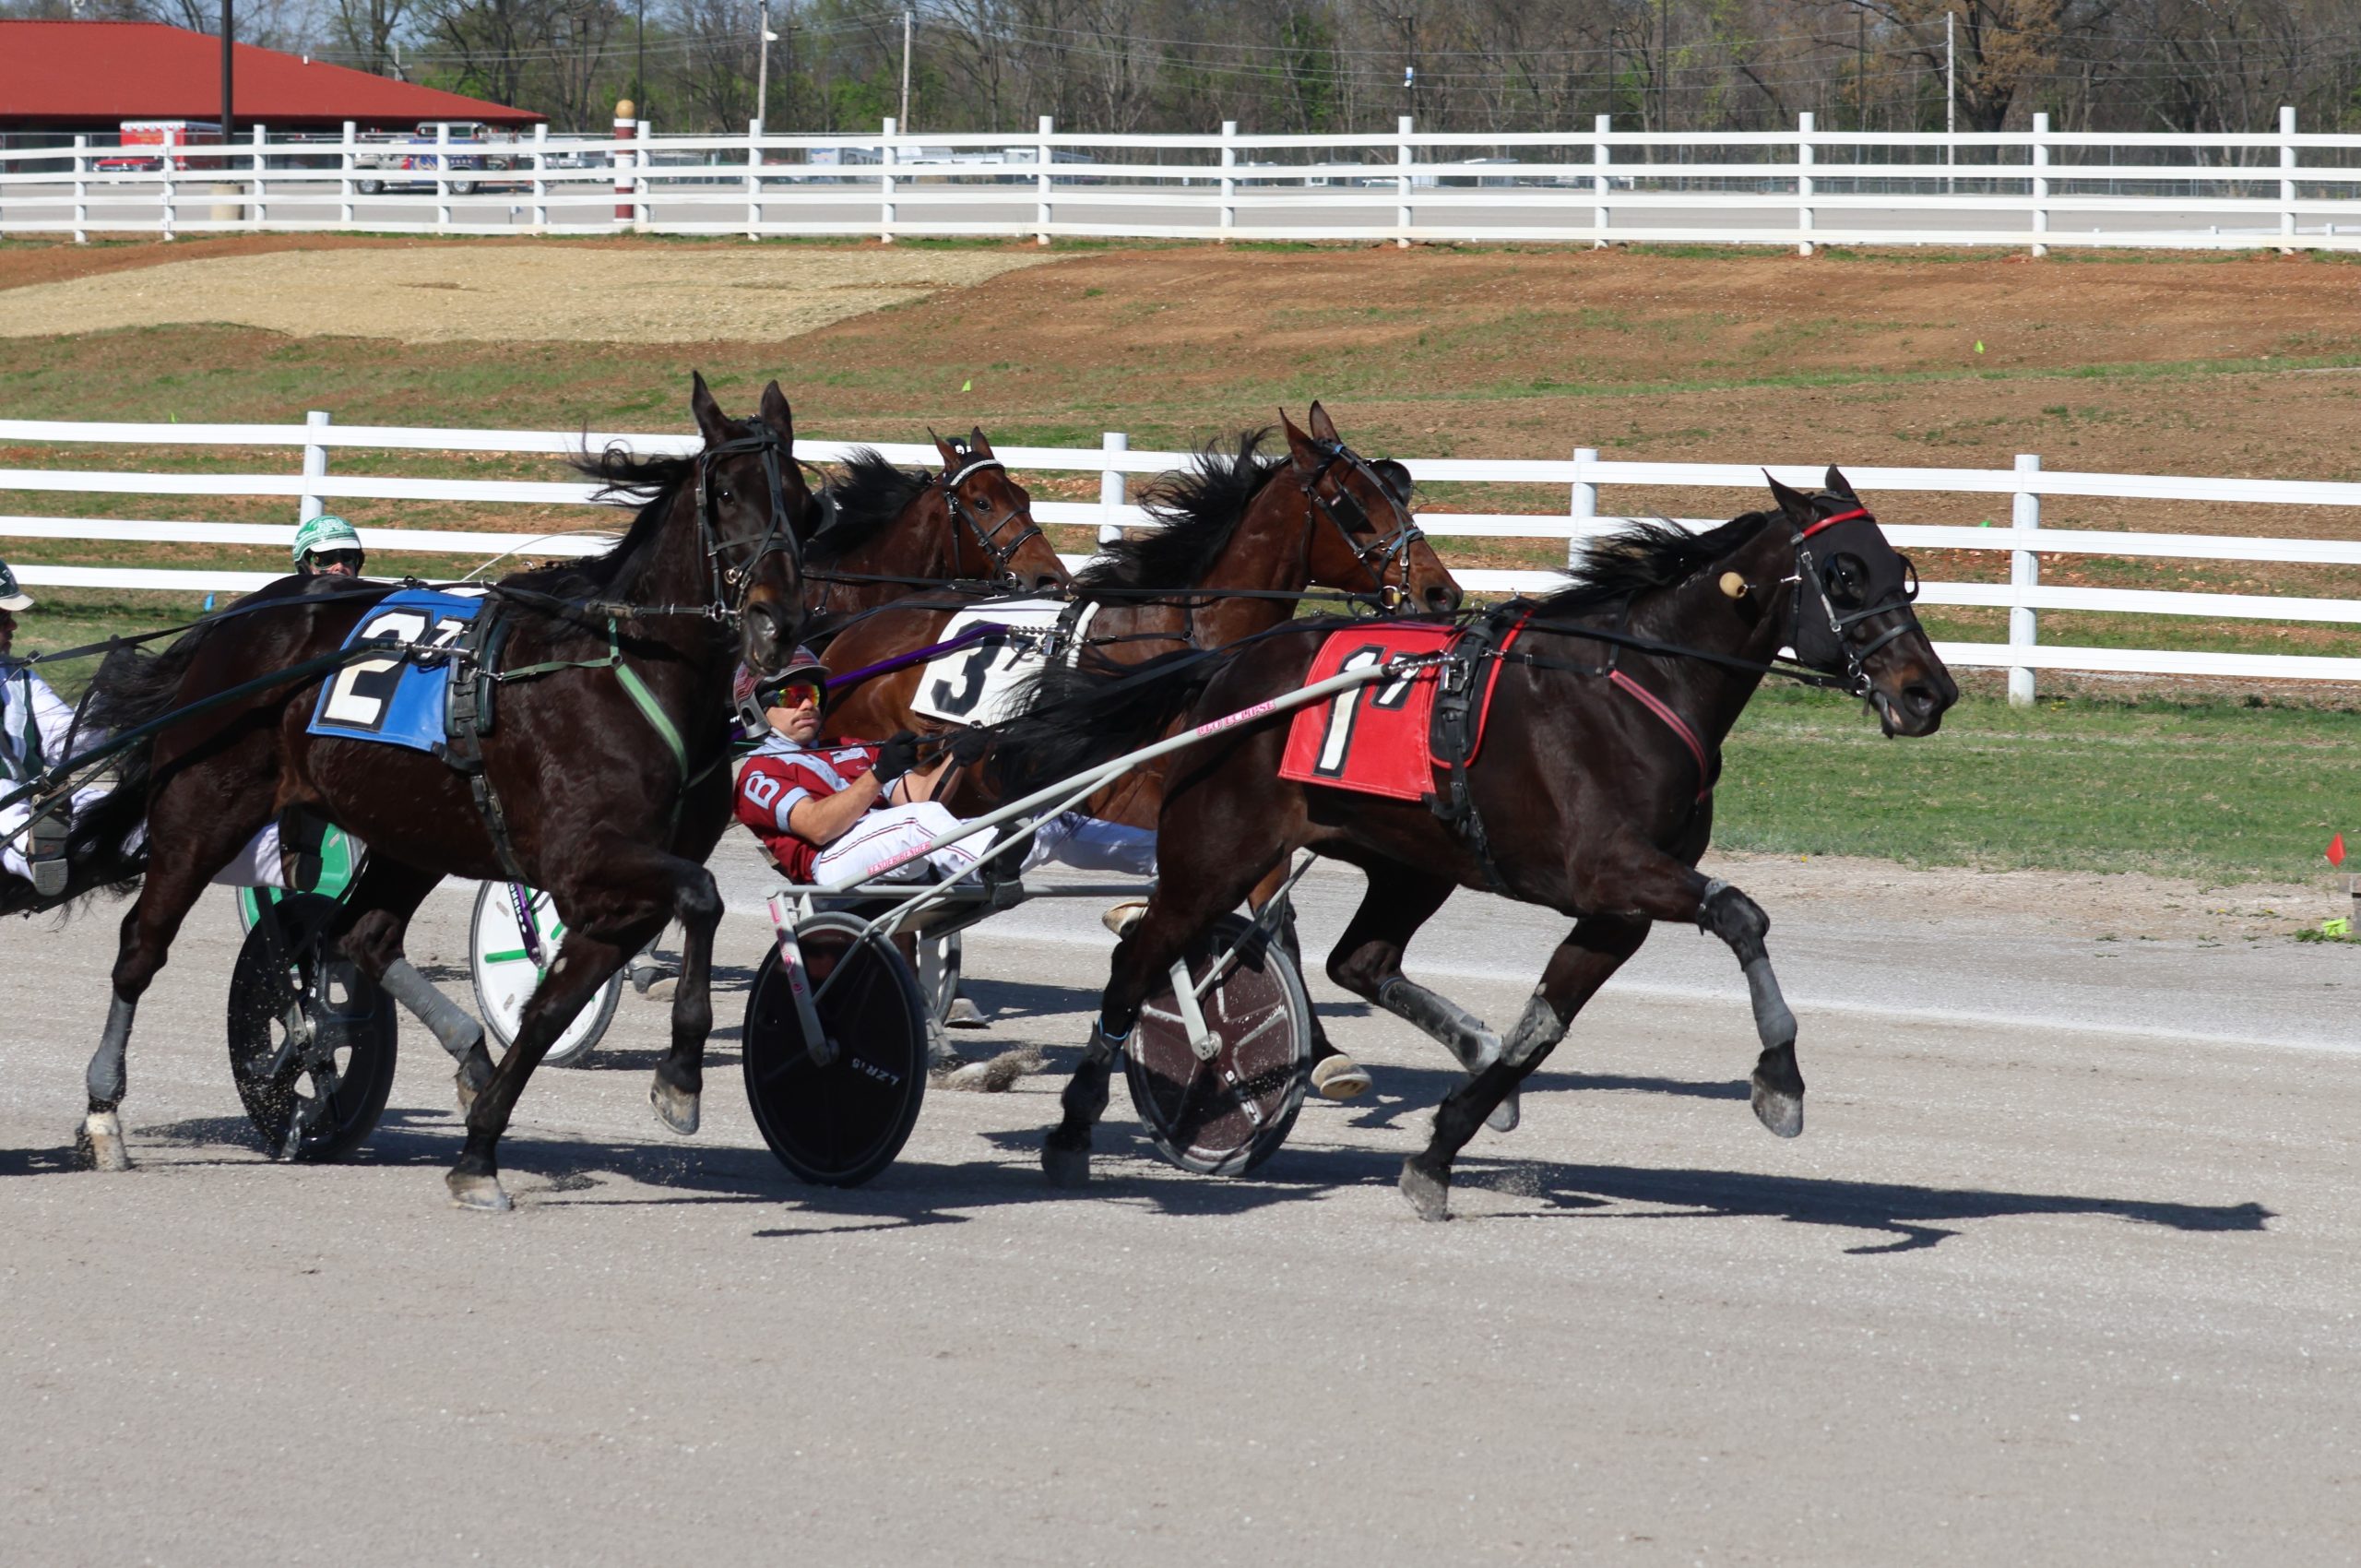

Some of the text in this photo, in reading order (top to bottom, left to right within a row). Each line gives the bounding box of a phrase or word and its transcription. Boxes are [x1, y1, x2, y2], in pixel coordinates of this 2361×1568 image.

[324, 612, 426, 725] 2
[930, 619, 1008, 718] 3
[1319, 650, 1378, 771] 1
[744, 770, 780, 810] B
